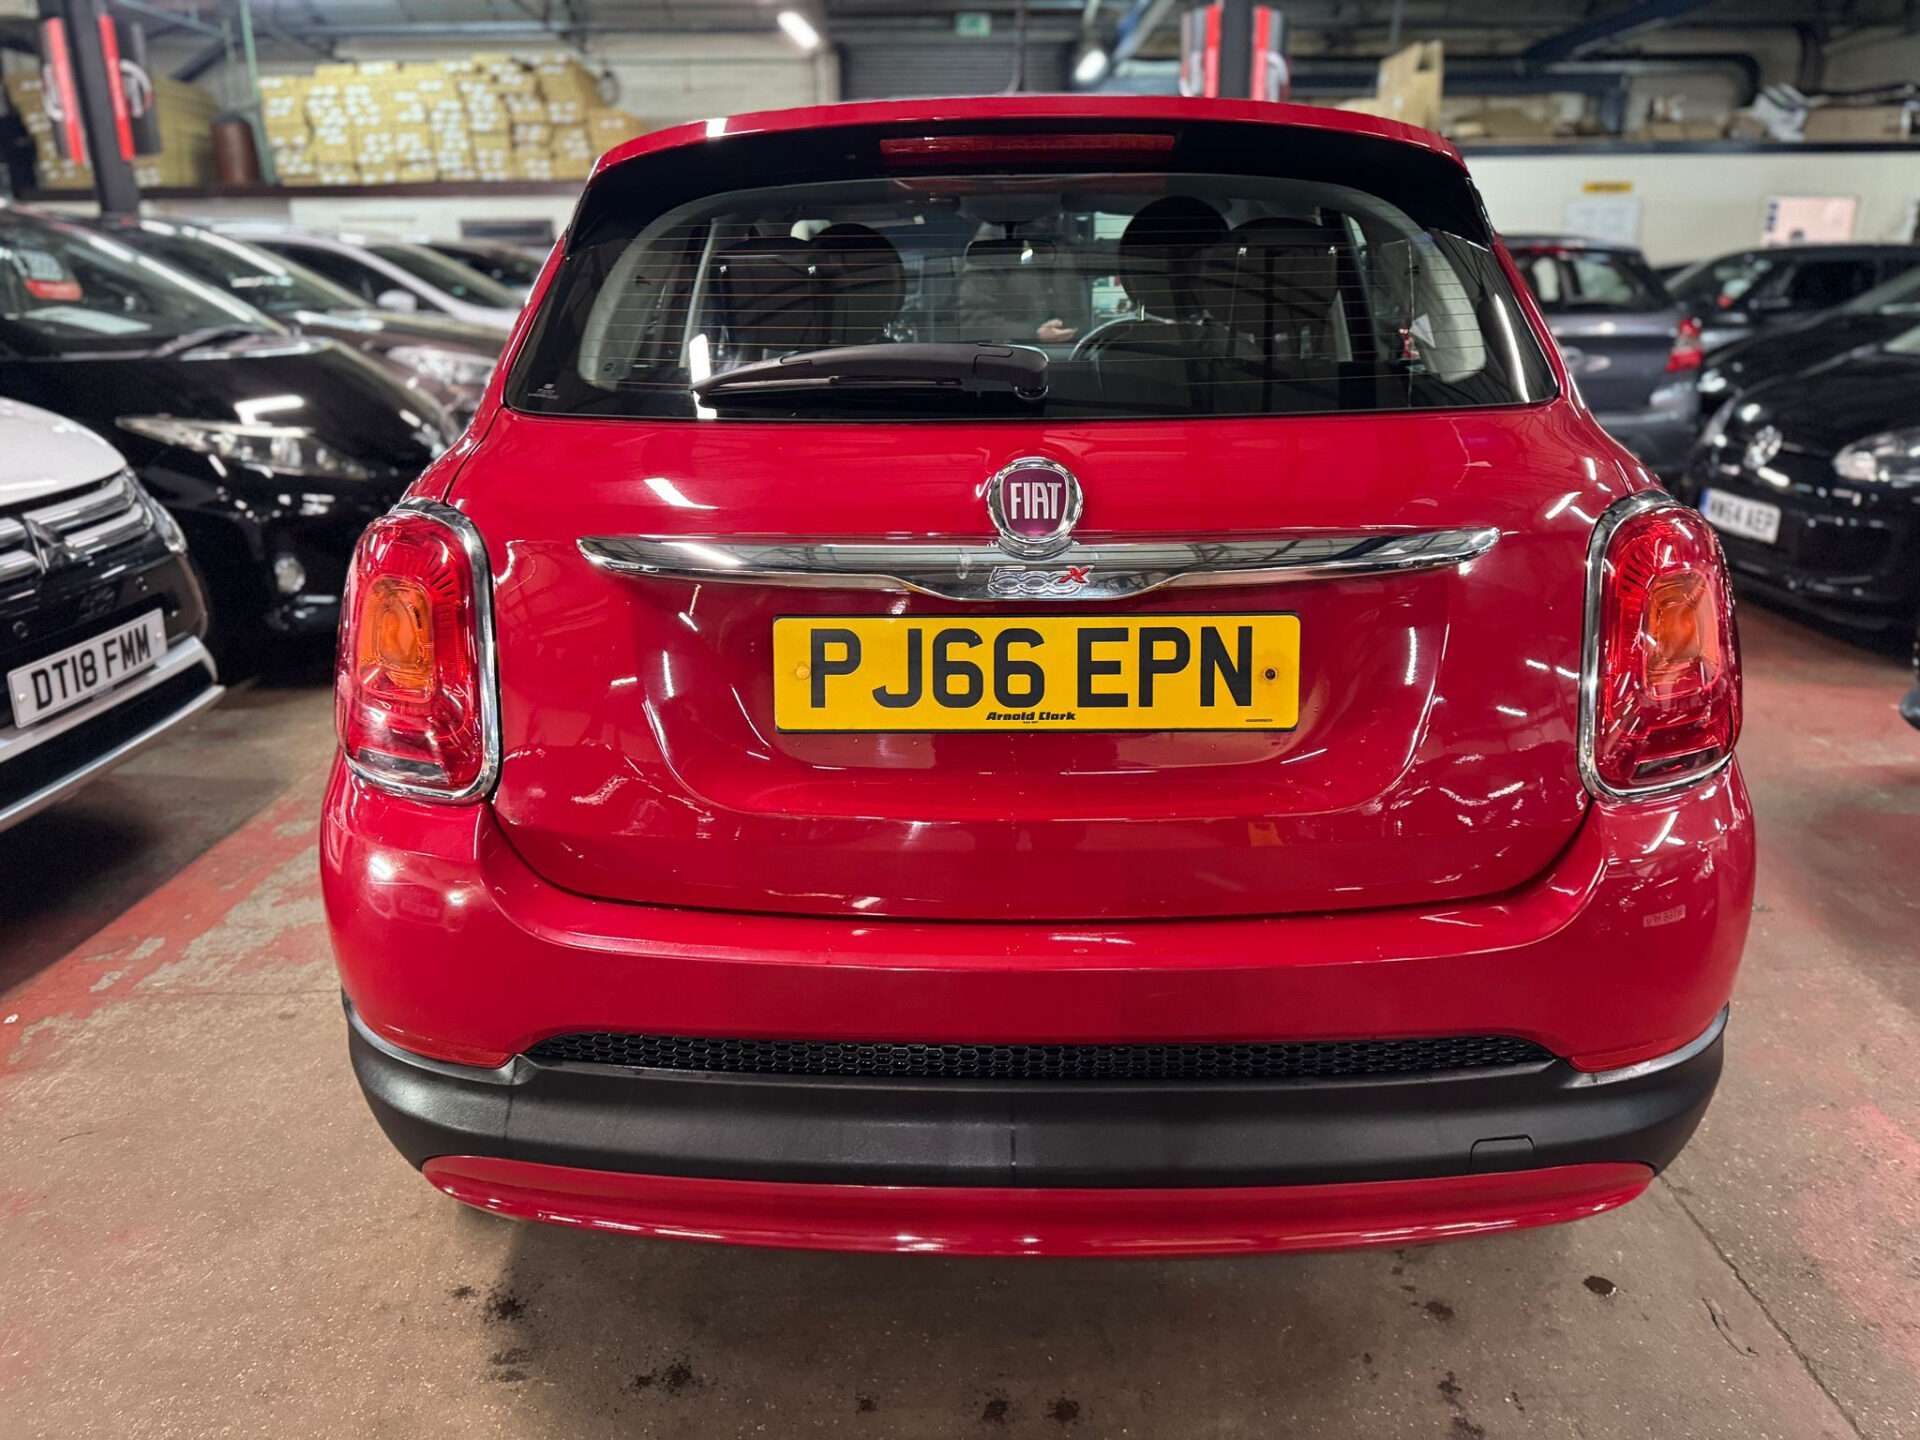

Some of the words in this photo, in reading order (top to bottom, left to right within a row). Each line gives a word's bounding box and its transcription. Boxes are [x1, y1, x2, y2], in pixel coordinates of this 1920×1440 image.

[1010, 482, 1062, 520] FIAT
[31, 649, 98, 711] DT18
[102, 623, 151, 679] FMM
[809, 627, 1046, 709] PJ66
[1076, 625, 1253, 708] EPN
[986, 711, 1035, 720] Arnold
[1038, 711, 1076, 720] Clark
